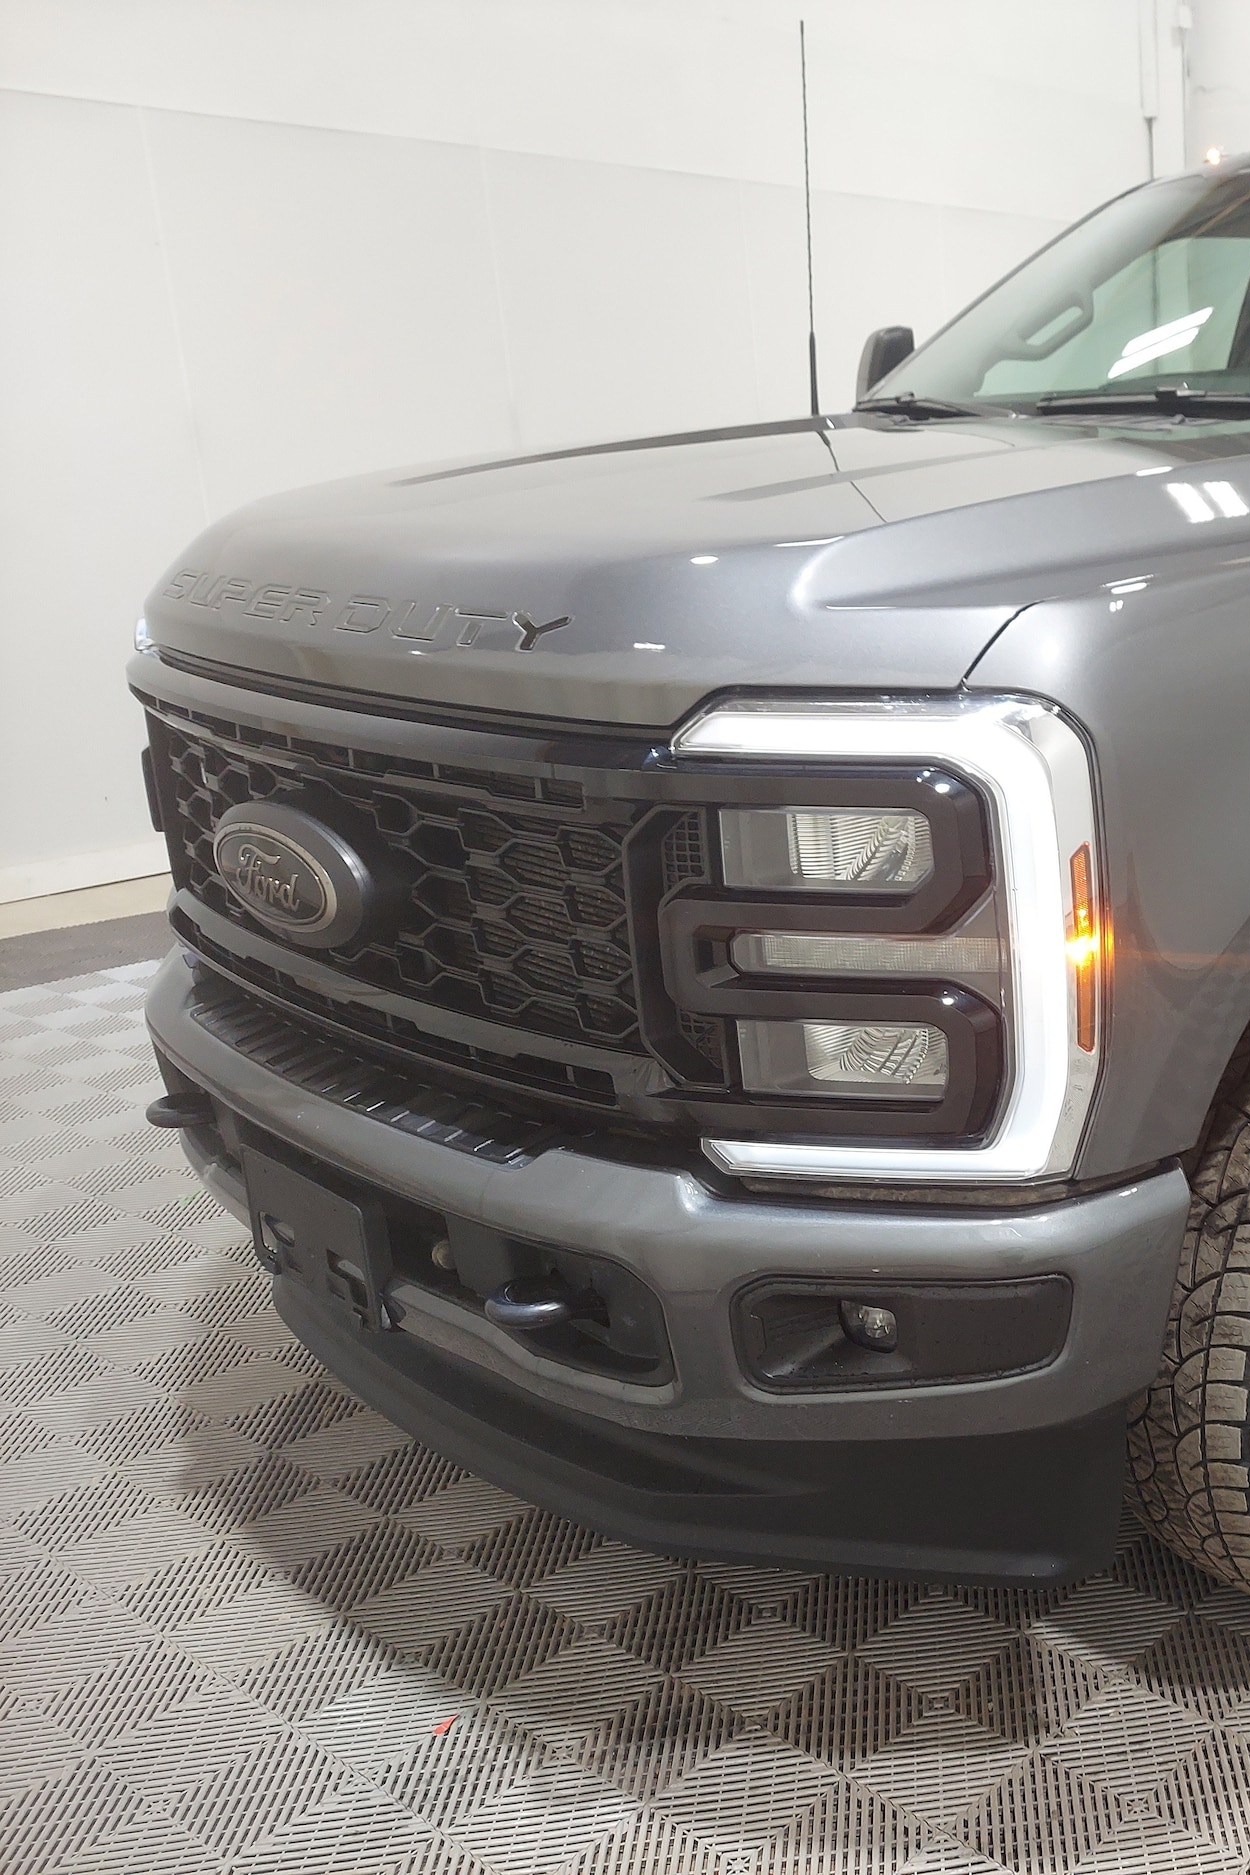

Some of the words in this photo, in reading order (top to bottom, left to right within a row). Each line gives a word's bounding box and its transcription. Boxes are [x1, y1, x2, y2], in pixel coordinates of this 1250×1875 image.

[163, 567, 331, 627] SUPER
[333, 594, 575, 653] DUTY
[236, 843, 300, 912] Ford
